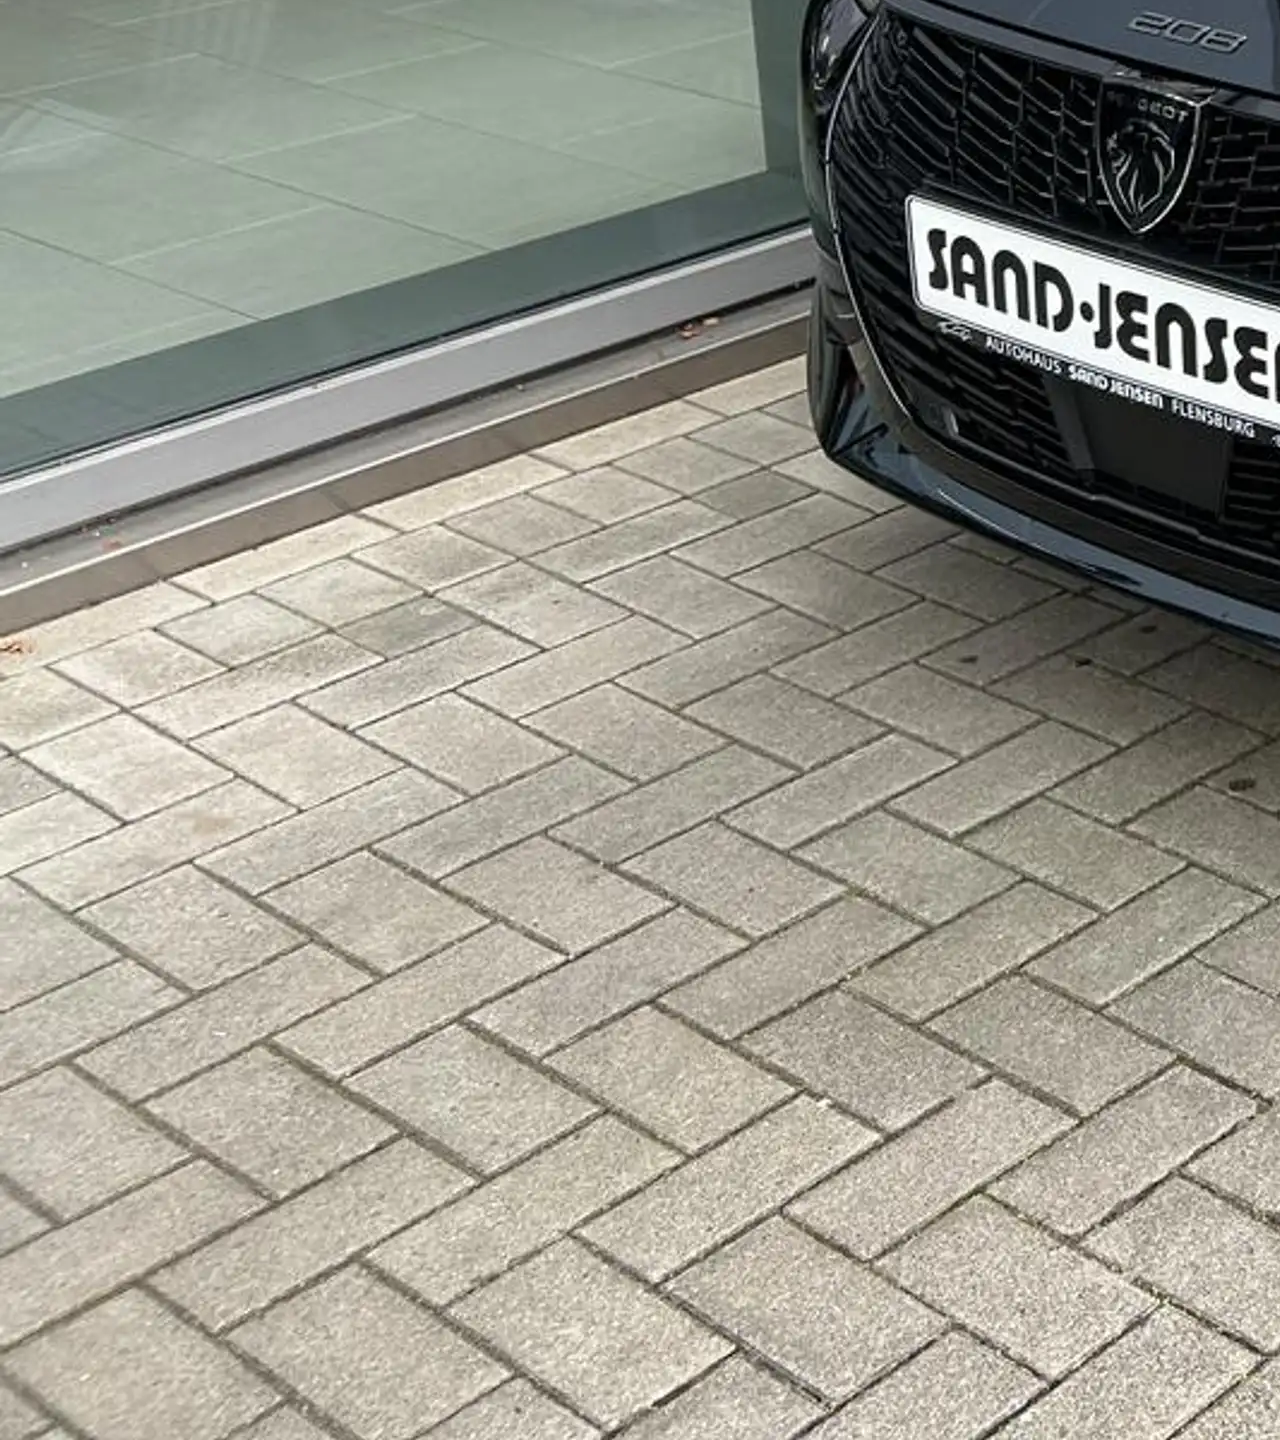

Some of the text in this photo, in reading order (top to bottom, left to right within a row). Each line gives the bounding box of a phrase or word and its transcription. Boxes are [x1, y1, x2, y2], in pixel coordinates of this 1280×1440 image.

[1129, 11, 1247, 52] 208
[985, 335, 1257, 438] AUTOHAUS SAND JENSEN FLENSBURG
